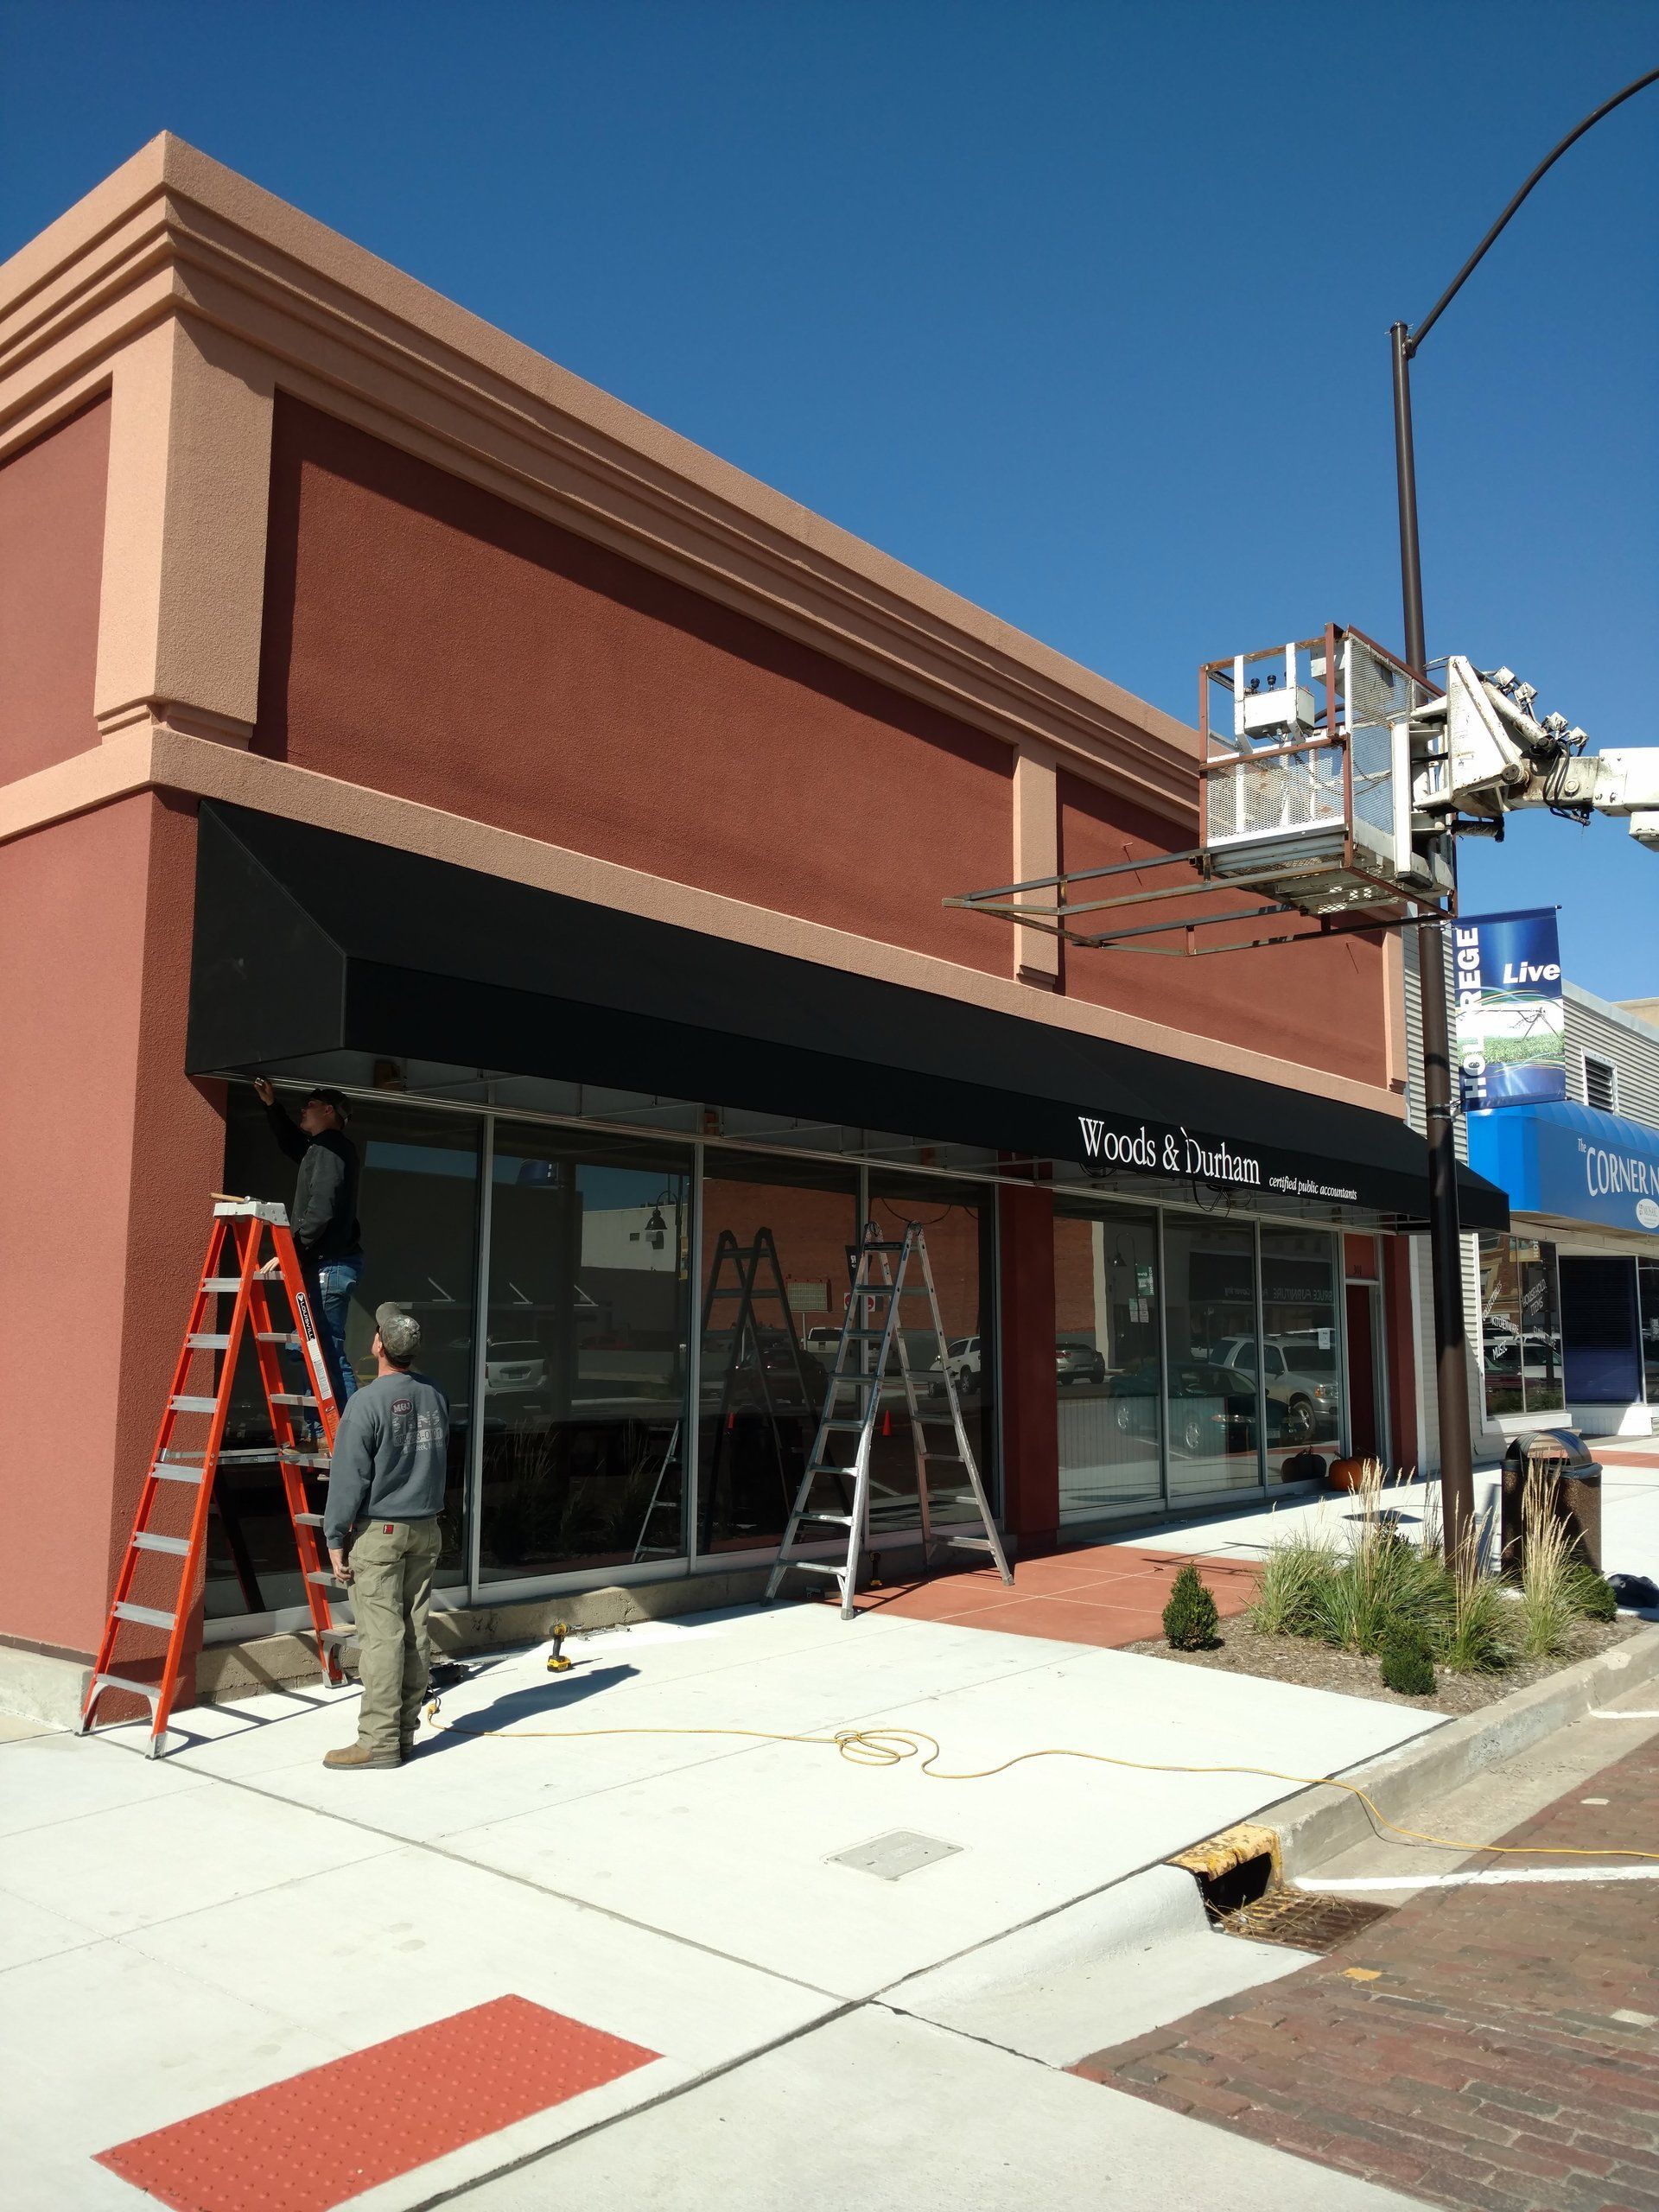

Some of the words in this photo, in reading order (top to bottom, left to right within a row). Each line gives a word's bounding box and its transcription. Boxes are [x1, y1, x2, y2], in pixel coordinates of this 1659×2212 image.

[1503, 961, 1560, 984] Live
[1457, 927, 1487, 1098] HOLREGE
[1078, 1116, 1156, 1167] Woods
[1162, 1134, 1180, 1173] &
[1181, 1127, 1261, 1185] Durham
[1578, 1137, 1586, 1153] The
[1586, 1147, 1649, 1197] CORNER
[1268, 1174, 1297, 1191] certified
[1298, 1179, 1319, 1195] public
[1319, 1185, 1357, 1201] accountants
[1482, 1280, 1503, 1322] COLLECTIBLES
[1522, 1278, 1547, 1308] HOUSEHOLD
[1530, 1296, 1543, 1316] ITEMS
[300, 1301, 316, 1339] LOUISVILL
[1491, 1316, 1520, 1335] KITCHENWARE
[1492, 1339, 1508, 1361] MUSIC
